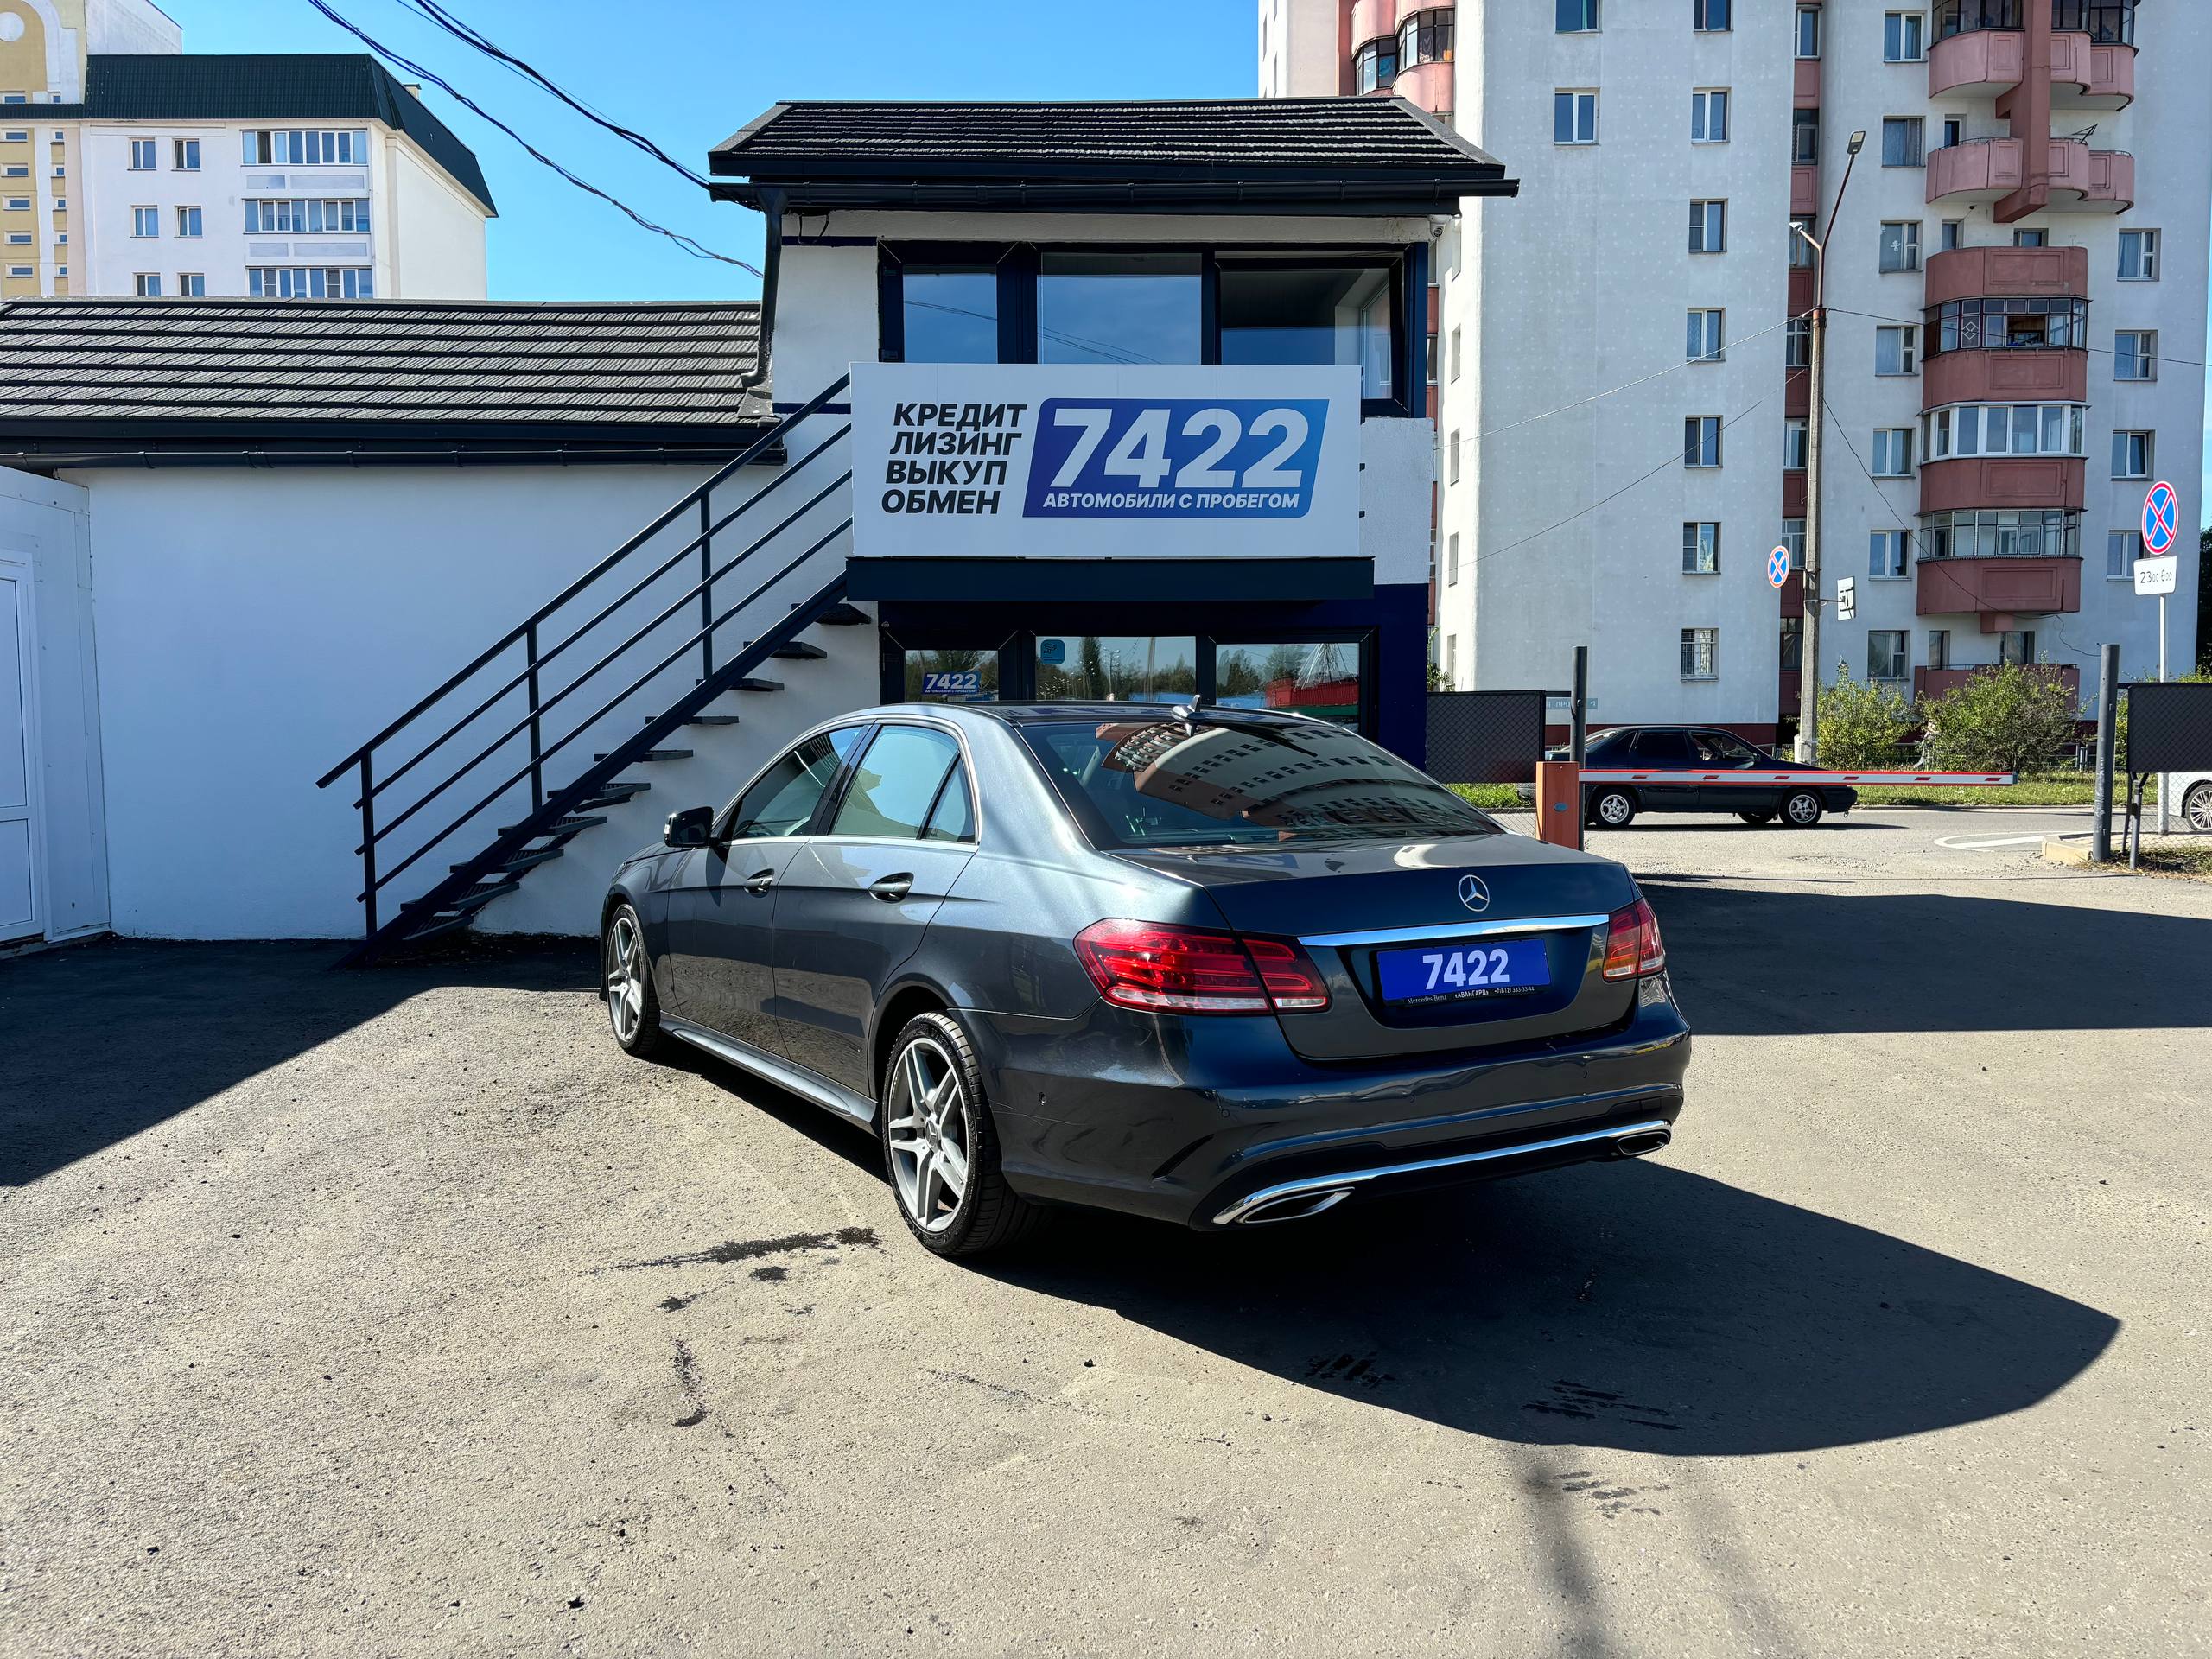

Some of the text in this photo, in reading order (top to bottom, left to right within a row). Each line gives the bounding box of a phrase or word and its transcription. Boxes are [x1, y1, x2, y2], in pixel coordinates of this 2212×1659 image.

[893, 403, 1027, 431] КРЕДИТ
[889, 432, 1023, 455] ЛИЗИНГ
[1049, 408, 1309, 488] 7422
[886, 460, 1007, 485] ВЫКУП
[881, 489, 1001, 514] ОБМЕН
[1043, 493, 1300, 509] АВТОМОБИЛИ С ПРОБЕГОМ
[926, 673, 977, 689] 7422
[1422, 948, 1510, 990] 7422
[1408, 995, 1447, 1004] Mercedes-Benz
